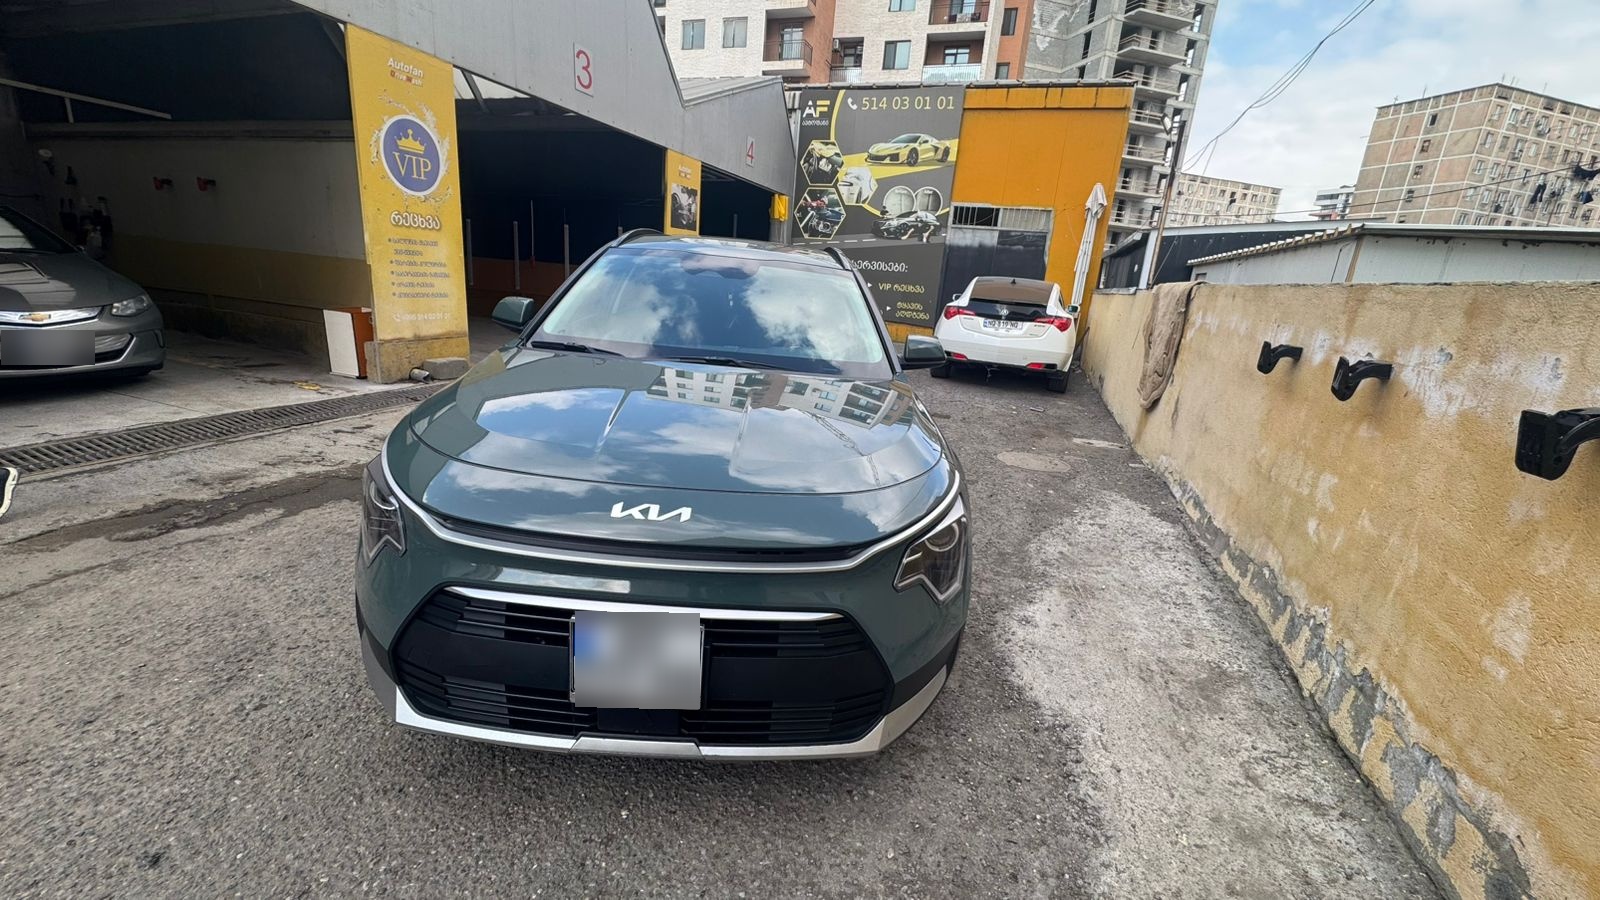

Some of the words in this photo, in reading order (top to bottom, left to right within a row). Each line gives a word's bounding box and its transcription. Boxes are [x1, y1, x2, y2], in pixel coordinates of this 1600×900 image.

[387, 57, 423, 78] Autofan
[576, 49, 592, 89] 3
[803, 100, 830, 118] AF
[861, 96, 887, 111] 514
[892, 96, 910, 110] 03
[914, 96, 932, 110] 01
[937, 96, 955, 110] 01
[746, 140, 755, 164] 4
[392, 151, 432, 180] VIP
[391, 211, 441, 230] რეცხვა
[878, 283, 892, 291] VIP
[893, 284, 925, 293] რეცხვა
[610, 501, 692, 523] KIA
